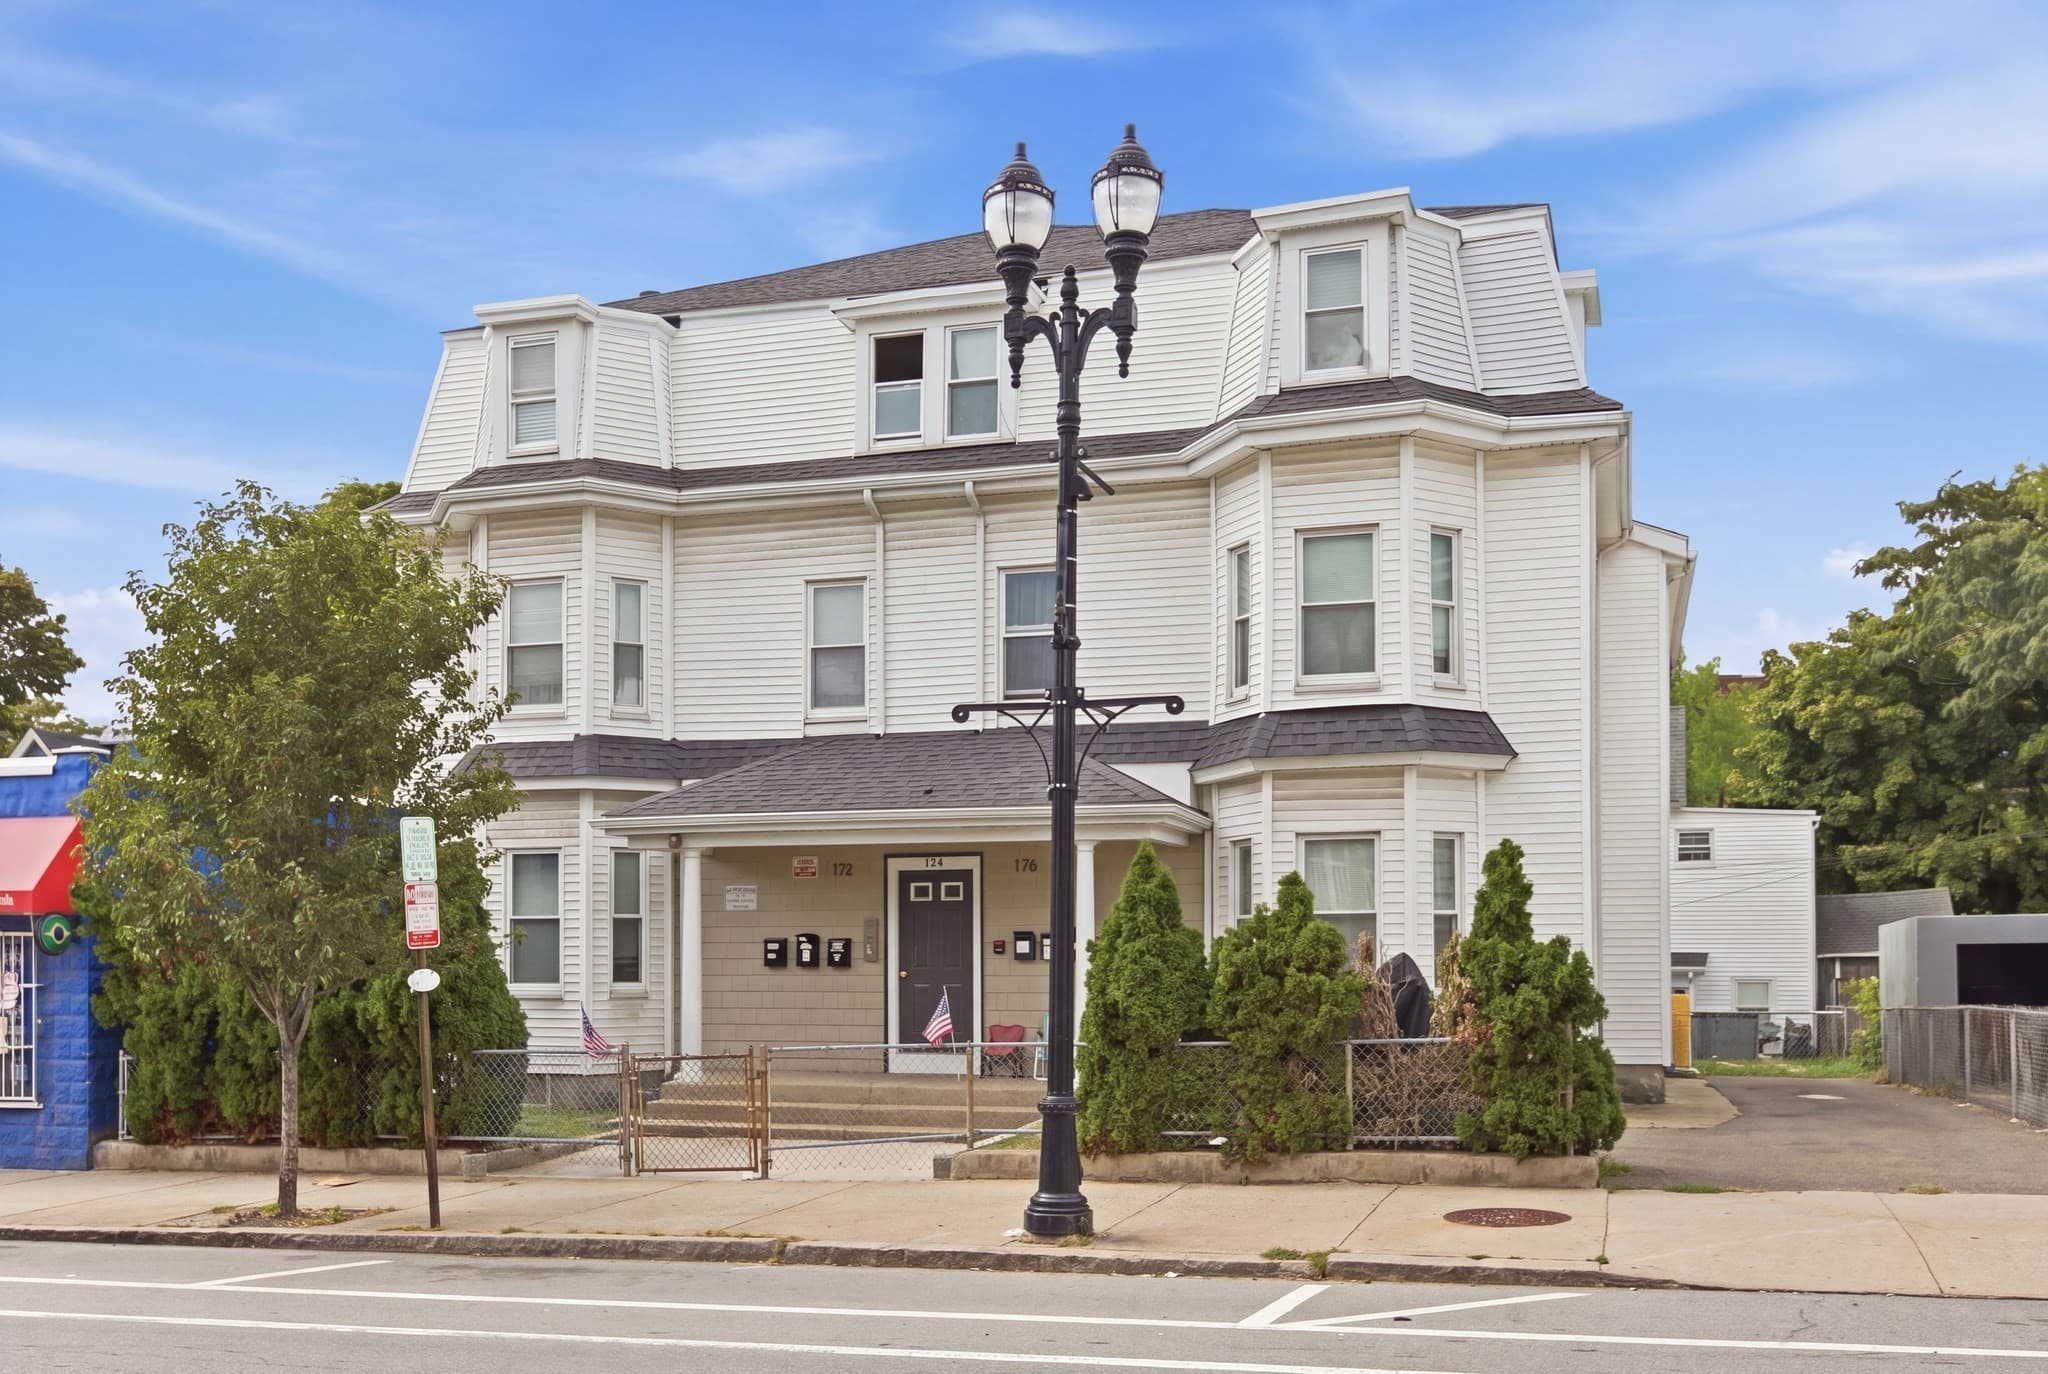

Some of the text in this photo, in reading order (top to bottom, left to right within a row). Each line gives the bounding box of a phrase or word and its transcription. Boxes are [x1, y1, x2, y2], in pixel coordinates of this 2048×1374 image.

[833, 862, 853, 876] 172
[925, 858, 943, 867] 124
[1015, 858, 1038, 872] 176
